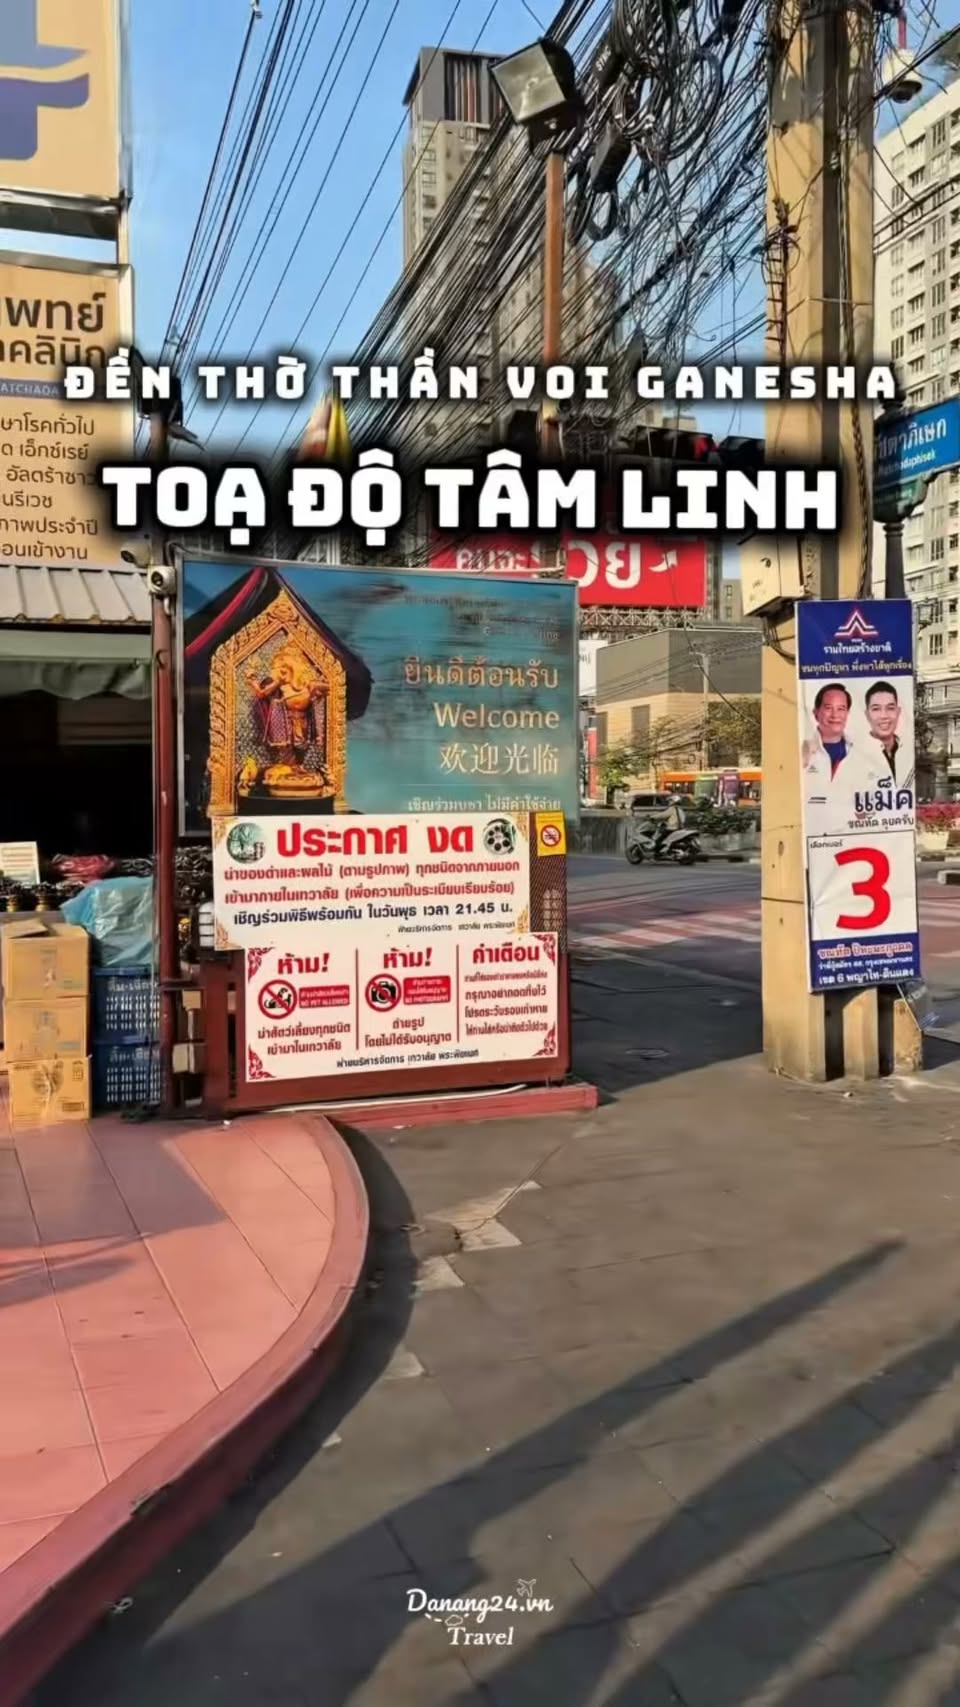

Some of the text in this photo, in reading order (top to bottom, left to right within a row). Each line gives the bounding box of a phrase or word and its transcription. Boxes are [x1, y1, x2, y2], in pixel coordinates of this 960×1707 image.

[0, 292, 106, 333] พทย์
[404, 656, 559, 688] ยินดีต้อนรับ
[434, 703, 560, 729] Welcome
[440, 743, 559, 775] 欢迎光临
[854, 776, 913, 812] แม็ค
[277, 823, 473, 857] ประกาศ งด
[834, 847, 892, 930] 3
[234, 902, 513, 927] เชิญร่วมพิธีพร้อมกัน ในวันพุธ เวลา 21.45 น.
[278, 953, 330, 975] ห้าม!
[383, 947, 432, 969] ห้าม!
[473, 942, 540, 964] คำเตือน
[837, 973, 844, 983] 6
